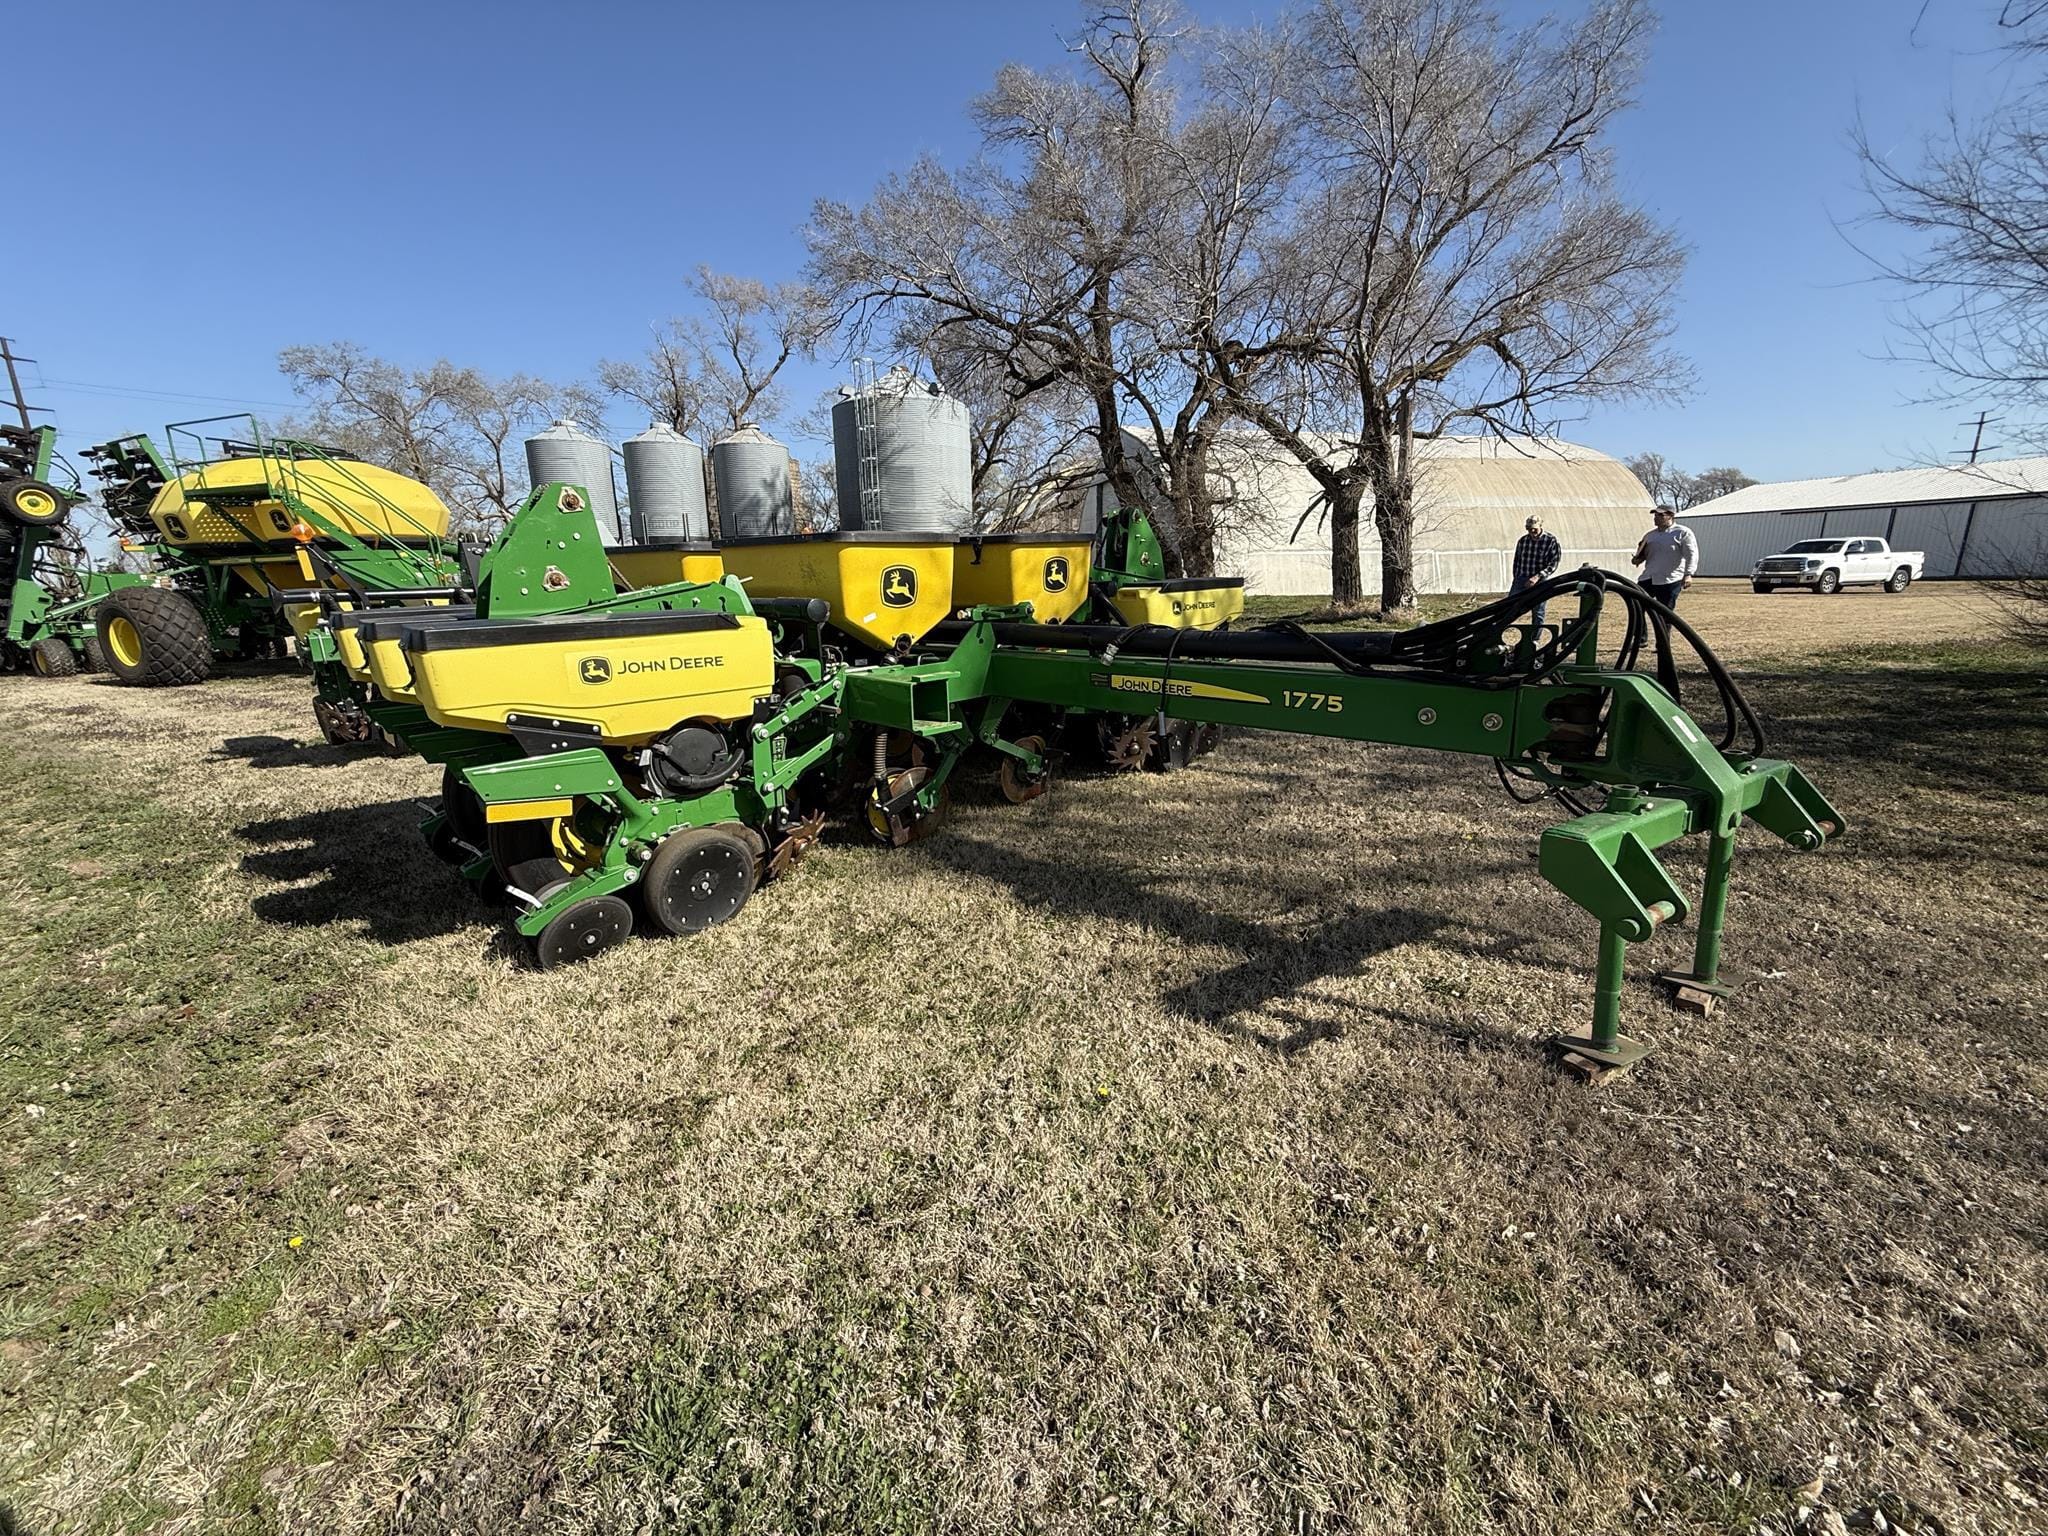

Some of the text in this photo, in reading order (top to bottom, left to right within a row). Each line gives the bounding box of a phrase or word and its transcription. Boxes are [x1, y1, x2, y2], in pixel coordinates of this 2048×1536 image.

[1183, 601, 1216, 611] JOHN DEERE
[617, 656, 724, 674] JOHN DEERE
[1118, 677, 1149, 691] JOHN
[1283, 690, 1343, 713] 1775
